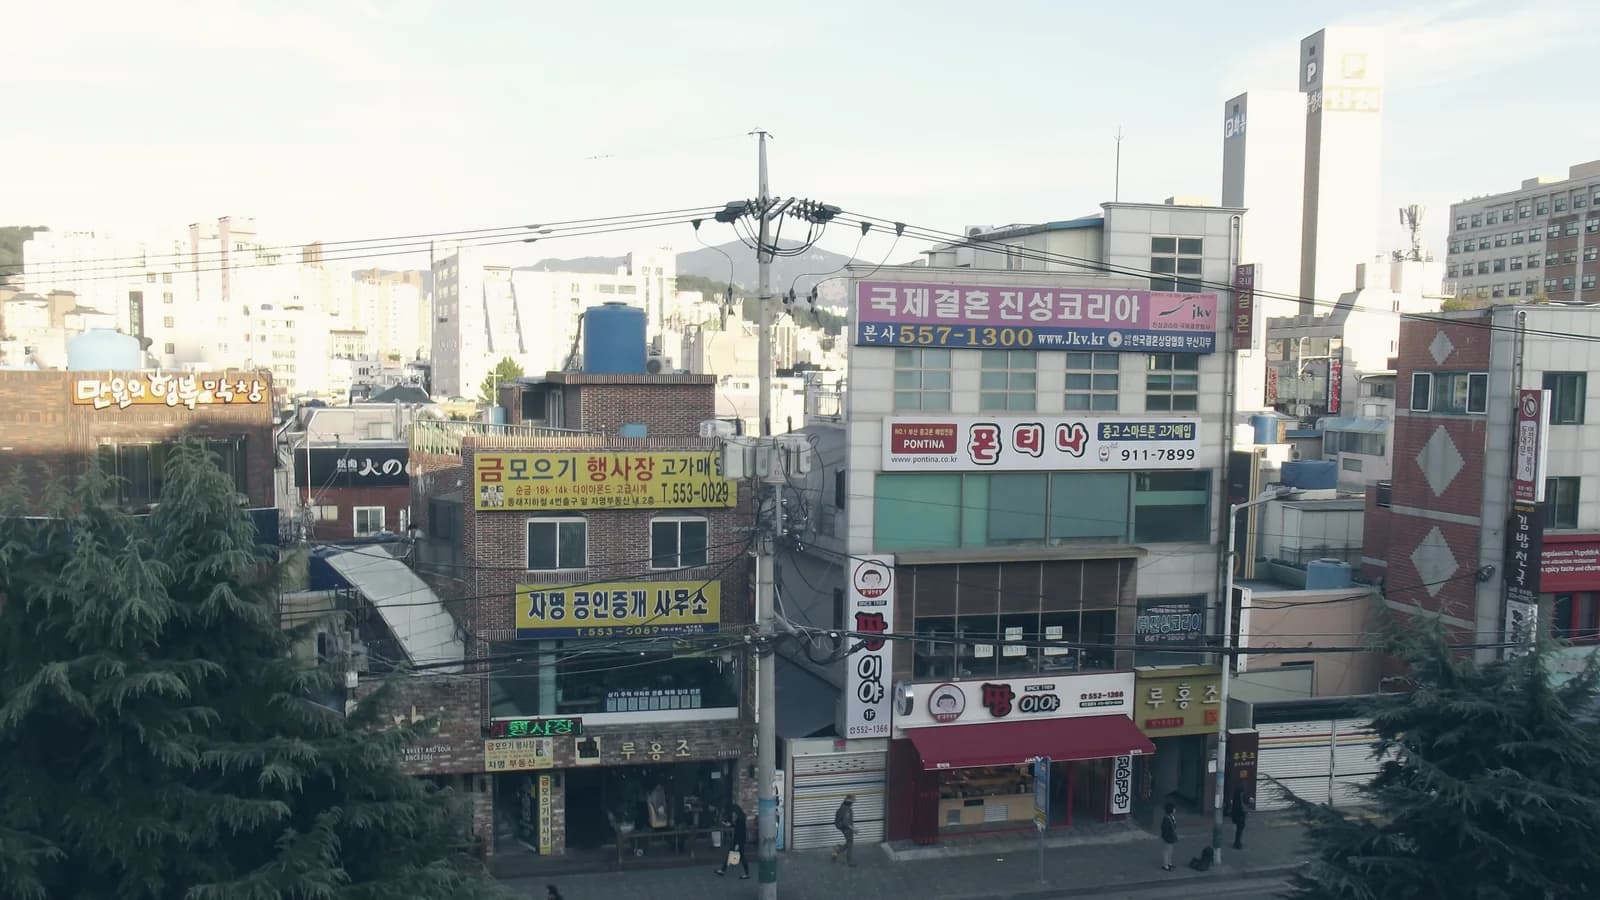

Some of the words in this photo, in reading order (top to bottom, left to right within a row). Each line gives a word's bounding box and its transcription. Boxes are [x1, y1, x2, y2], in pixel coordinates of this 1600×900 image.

[1307, 62, 1317, 83] P
[870, 287, 990, 320] 국제결혼
[999, 291, 1140, 323] 진성코리아
[1192, 304, 1212, 320] jkv
[864, 325, 896, 343] 본사
[900, 326, 1034, 347] 557-1300
[1038, 332, 1105, 345] www.Jkv.kr
[1103, 425, 1120, 439] 중고
[1123, 425, 1156, 439] 스마트폰
[1158, 424, 1192, 439] 고가매입
[903, 439, 945, 449] PONTINA
[968, 422, 1090, 465] 폰티나
[891, 456, 958, 464] www.pontina.co.kr
[1121, 449, 1195, 461] 911-7899
[587, 456, 655, 481] 행사장
[662, 482, 729, 505] T.553-0029
[1515, 514, 1529, 586] 김밥천국
[529, 592, 566, 621] 자명
[573, 591, 647, 620] 공인중개
[654, 588, 708, 617] 사무소
[865, 710, 875, 720] 1F
[509, 719, 574, 736] 행사장
[509, 758, 536, 768] 부동산
